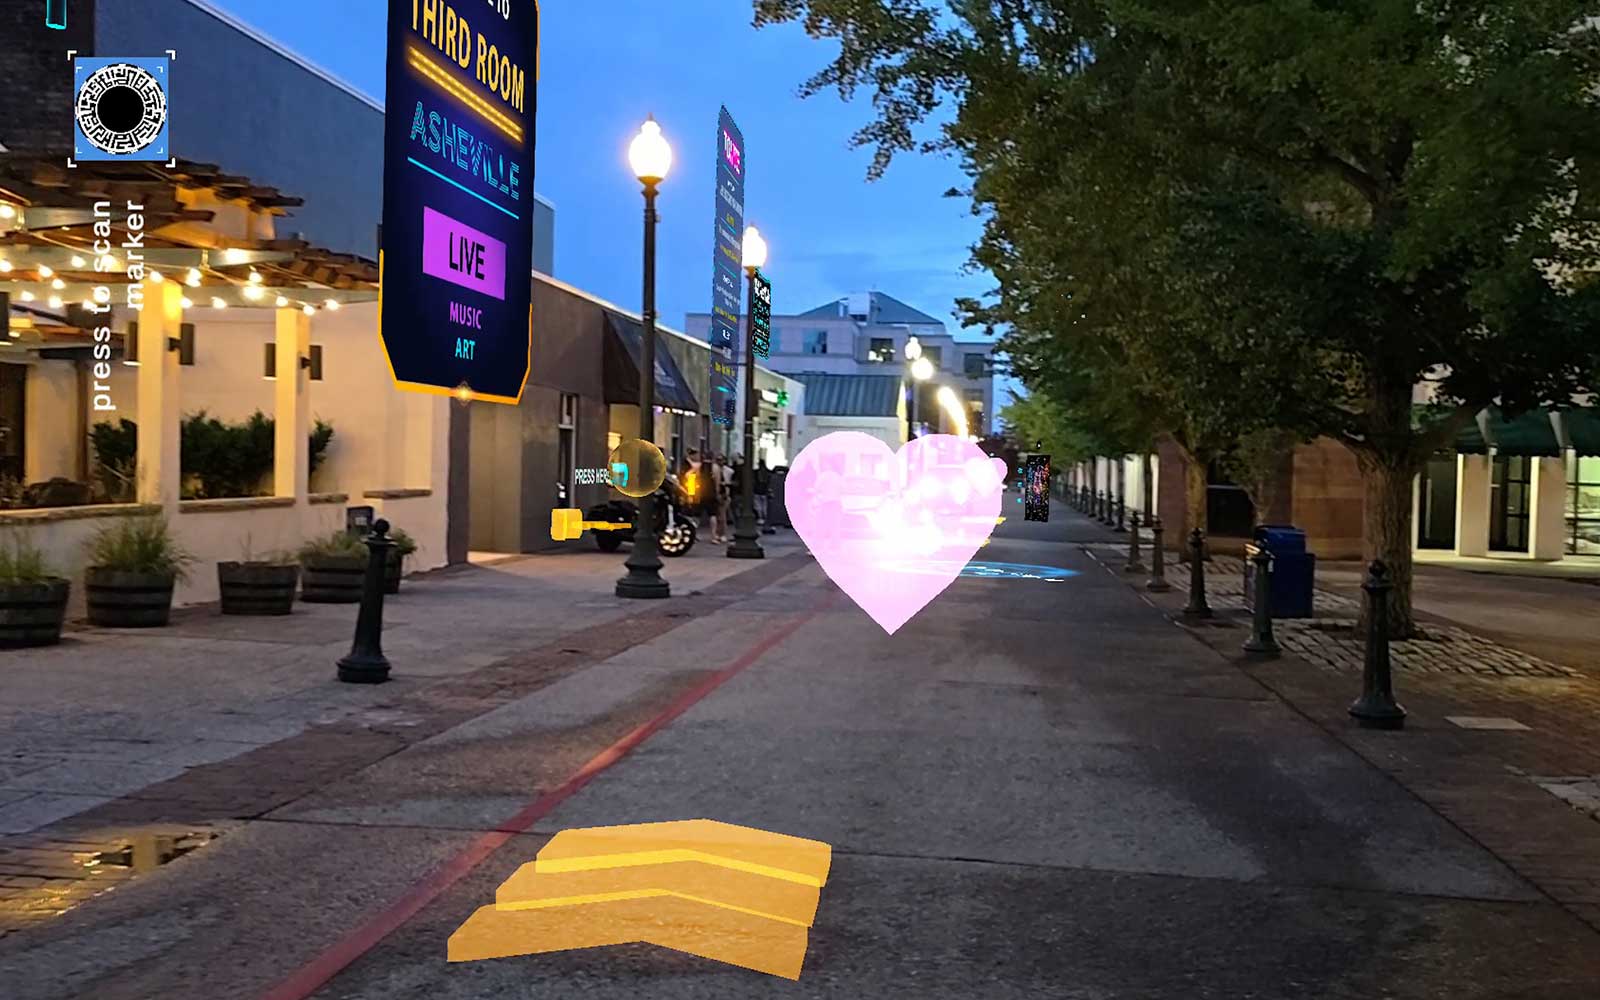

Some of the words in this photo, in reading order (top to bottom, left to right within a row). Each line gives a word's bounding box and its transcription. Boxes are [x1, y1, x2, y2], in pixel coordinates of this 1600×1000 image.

[476, 32, 524, 113] ROOM
[449, 232, 485, 280] LIVE
[450, 301, 482, 329] MUSIC
[455, 337, 475, 360] ART
